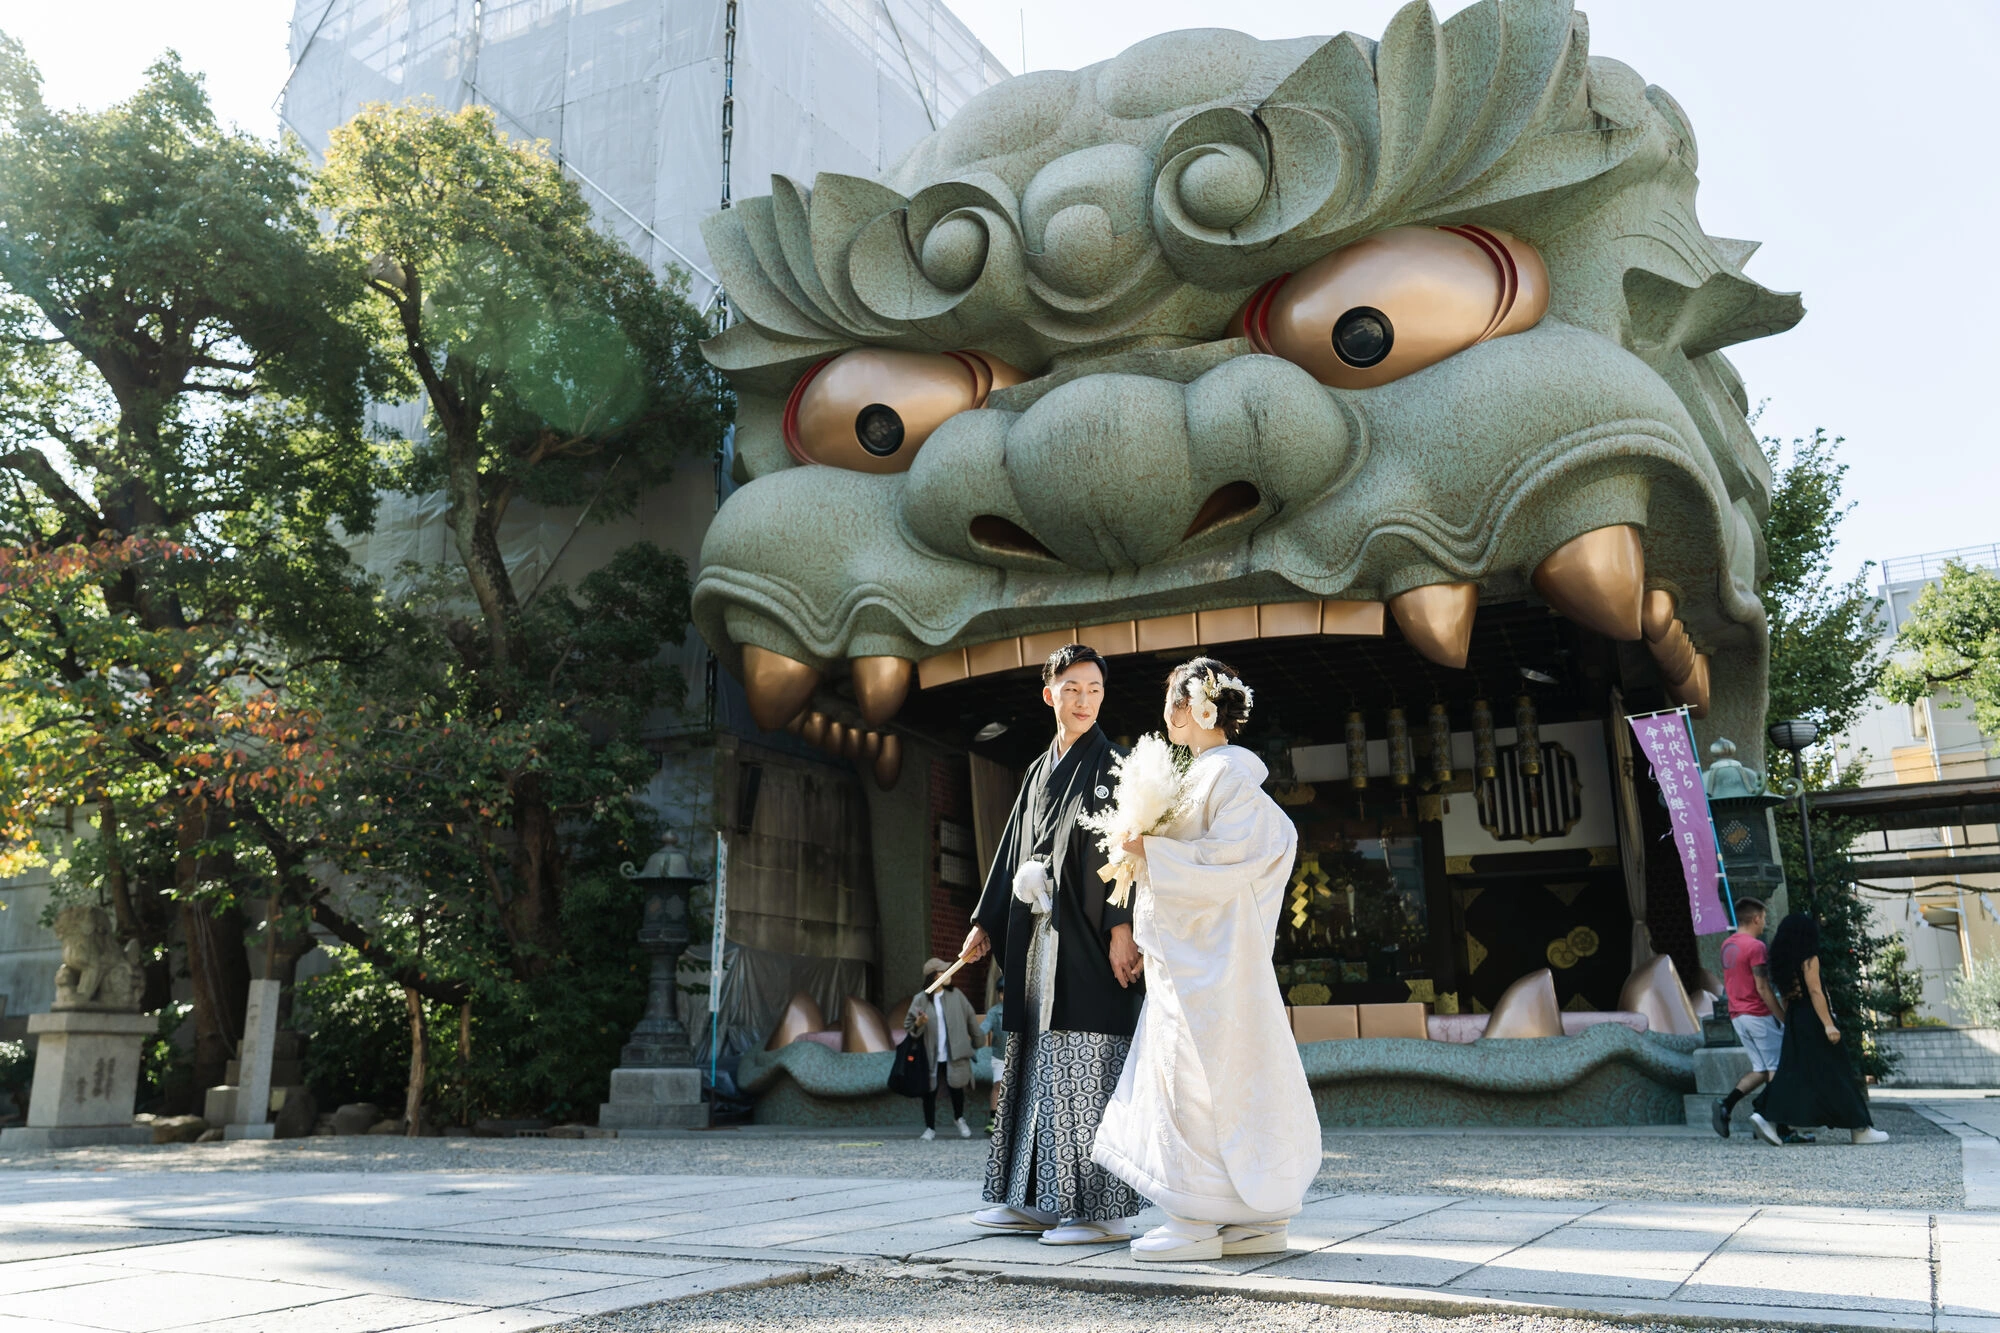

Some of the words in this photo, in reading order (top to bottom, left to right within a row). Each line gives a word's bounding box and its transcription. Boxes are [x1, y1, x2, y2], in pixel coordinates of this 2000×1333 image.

[1645, 726, 1688, 824] 令和に受け継ぐ
[1661, 722, 1693, 789] 神代から
